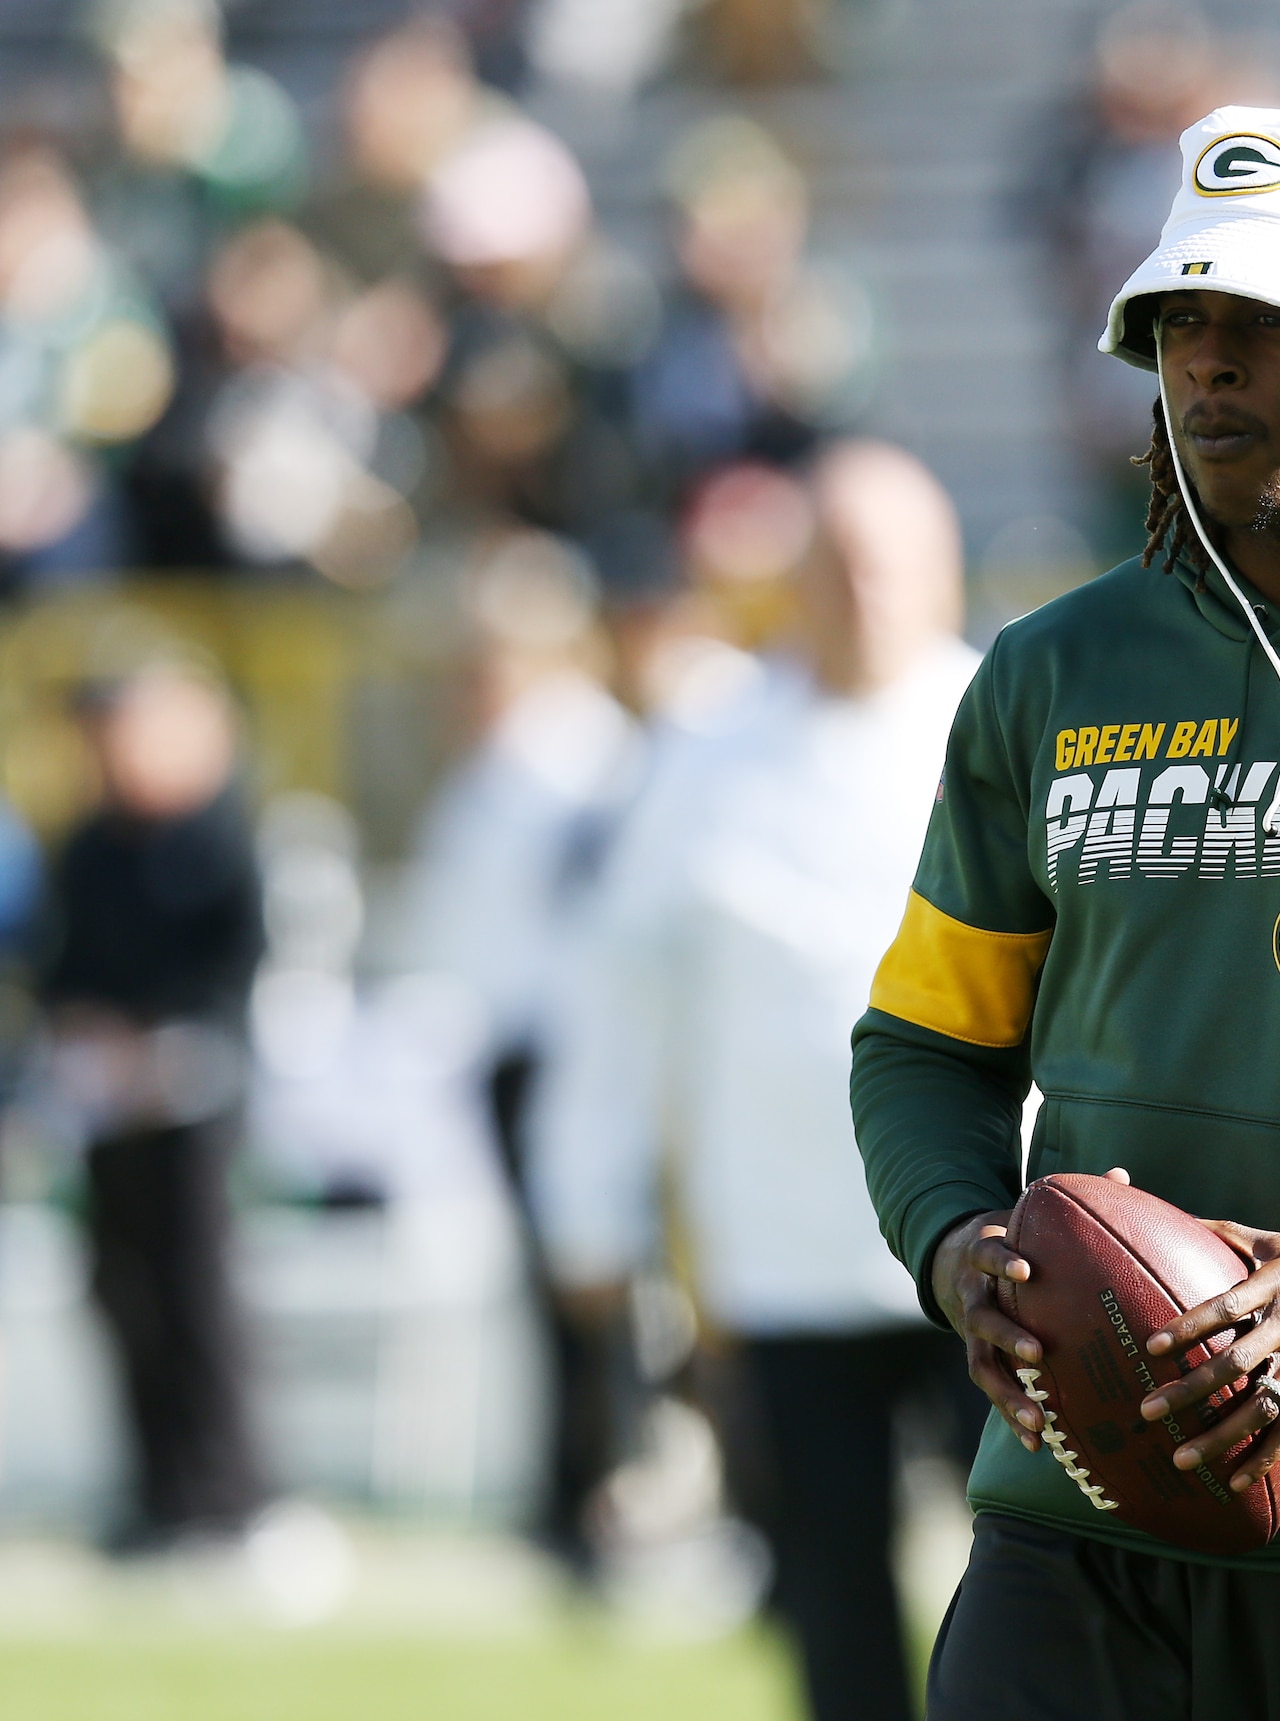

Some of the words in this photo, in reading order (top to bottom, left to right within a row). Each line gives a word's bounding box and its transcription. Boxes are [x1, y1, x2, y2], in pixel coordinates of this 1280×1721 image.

[1055, 722, 1166, 772] GREEN
[1165, 717, 1239, 759] BAY
[1100, 1289, 1139, 1358] LEAGUE
[1196, 1464, 1232, 1506] NATION
